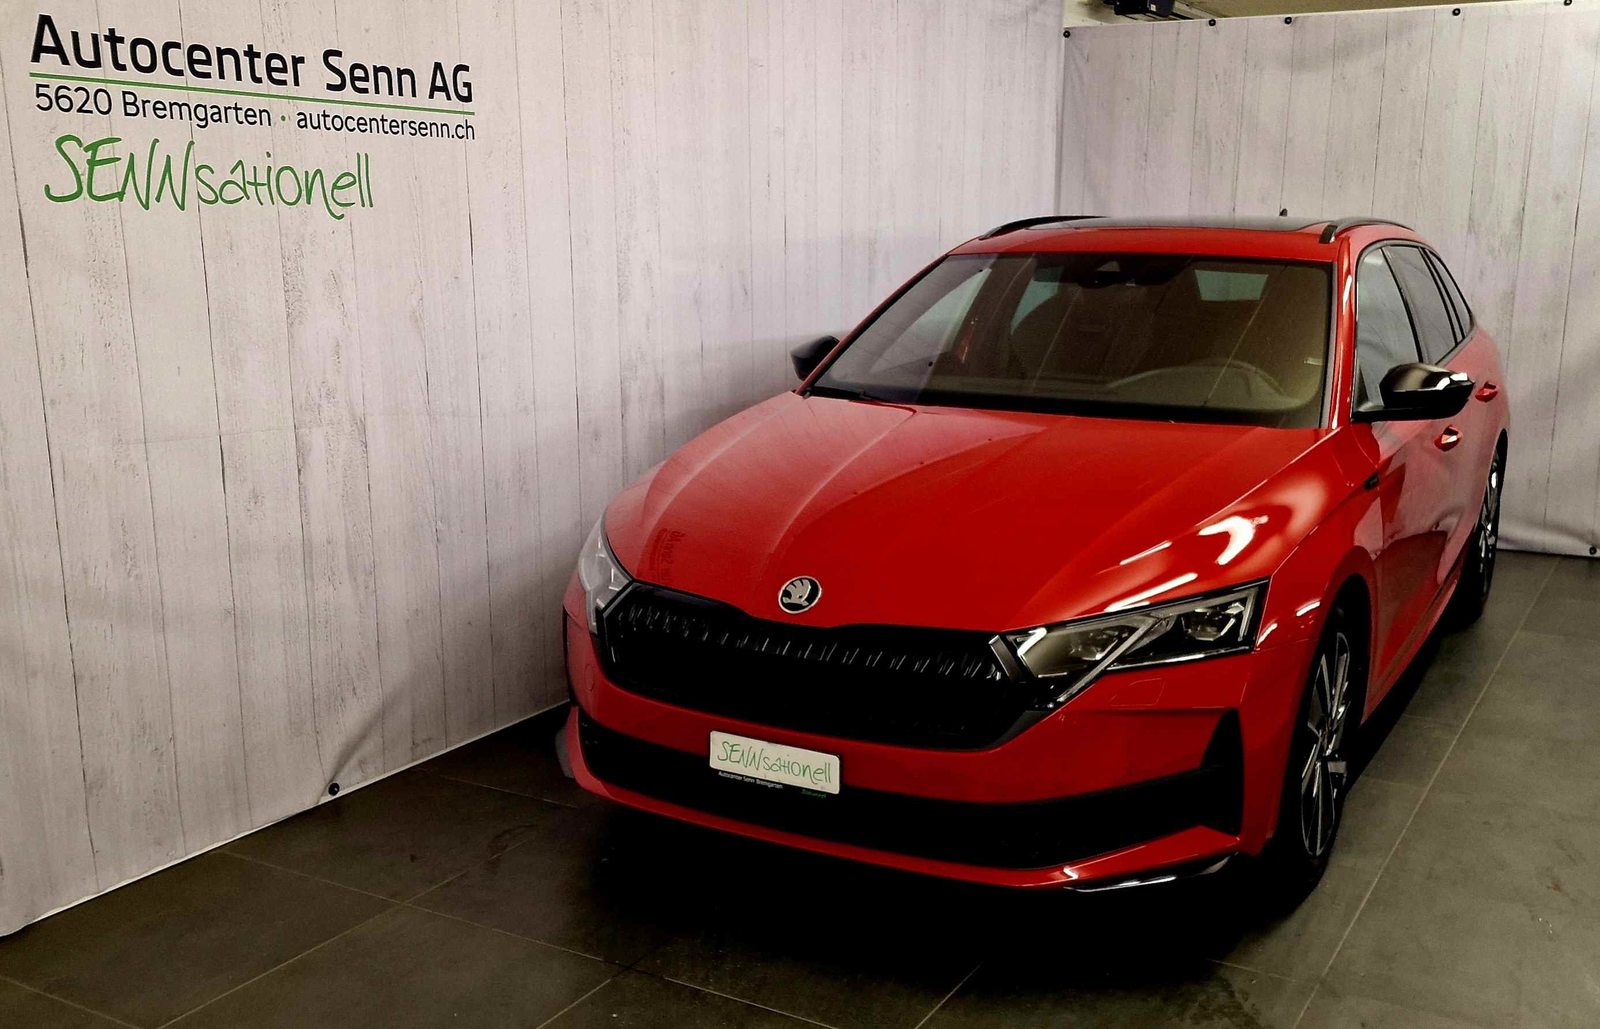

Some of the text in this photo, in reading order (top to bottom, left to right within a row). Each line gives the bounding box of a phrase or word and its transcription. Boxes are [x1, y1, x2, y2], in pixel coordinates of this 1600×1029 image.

[31, 14, 473, 103] Autocenter Senn AG
[35, 84, 475, 140] 5620 Bremgarten autocentersenn.ch
[44, 134, 374, 220] SENNsationell
[717, 741, 832, 785] SENNsationell
